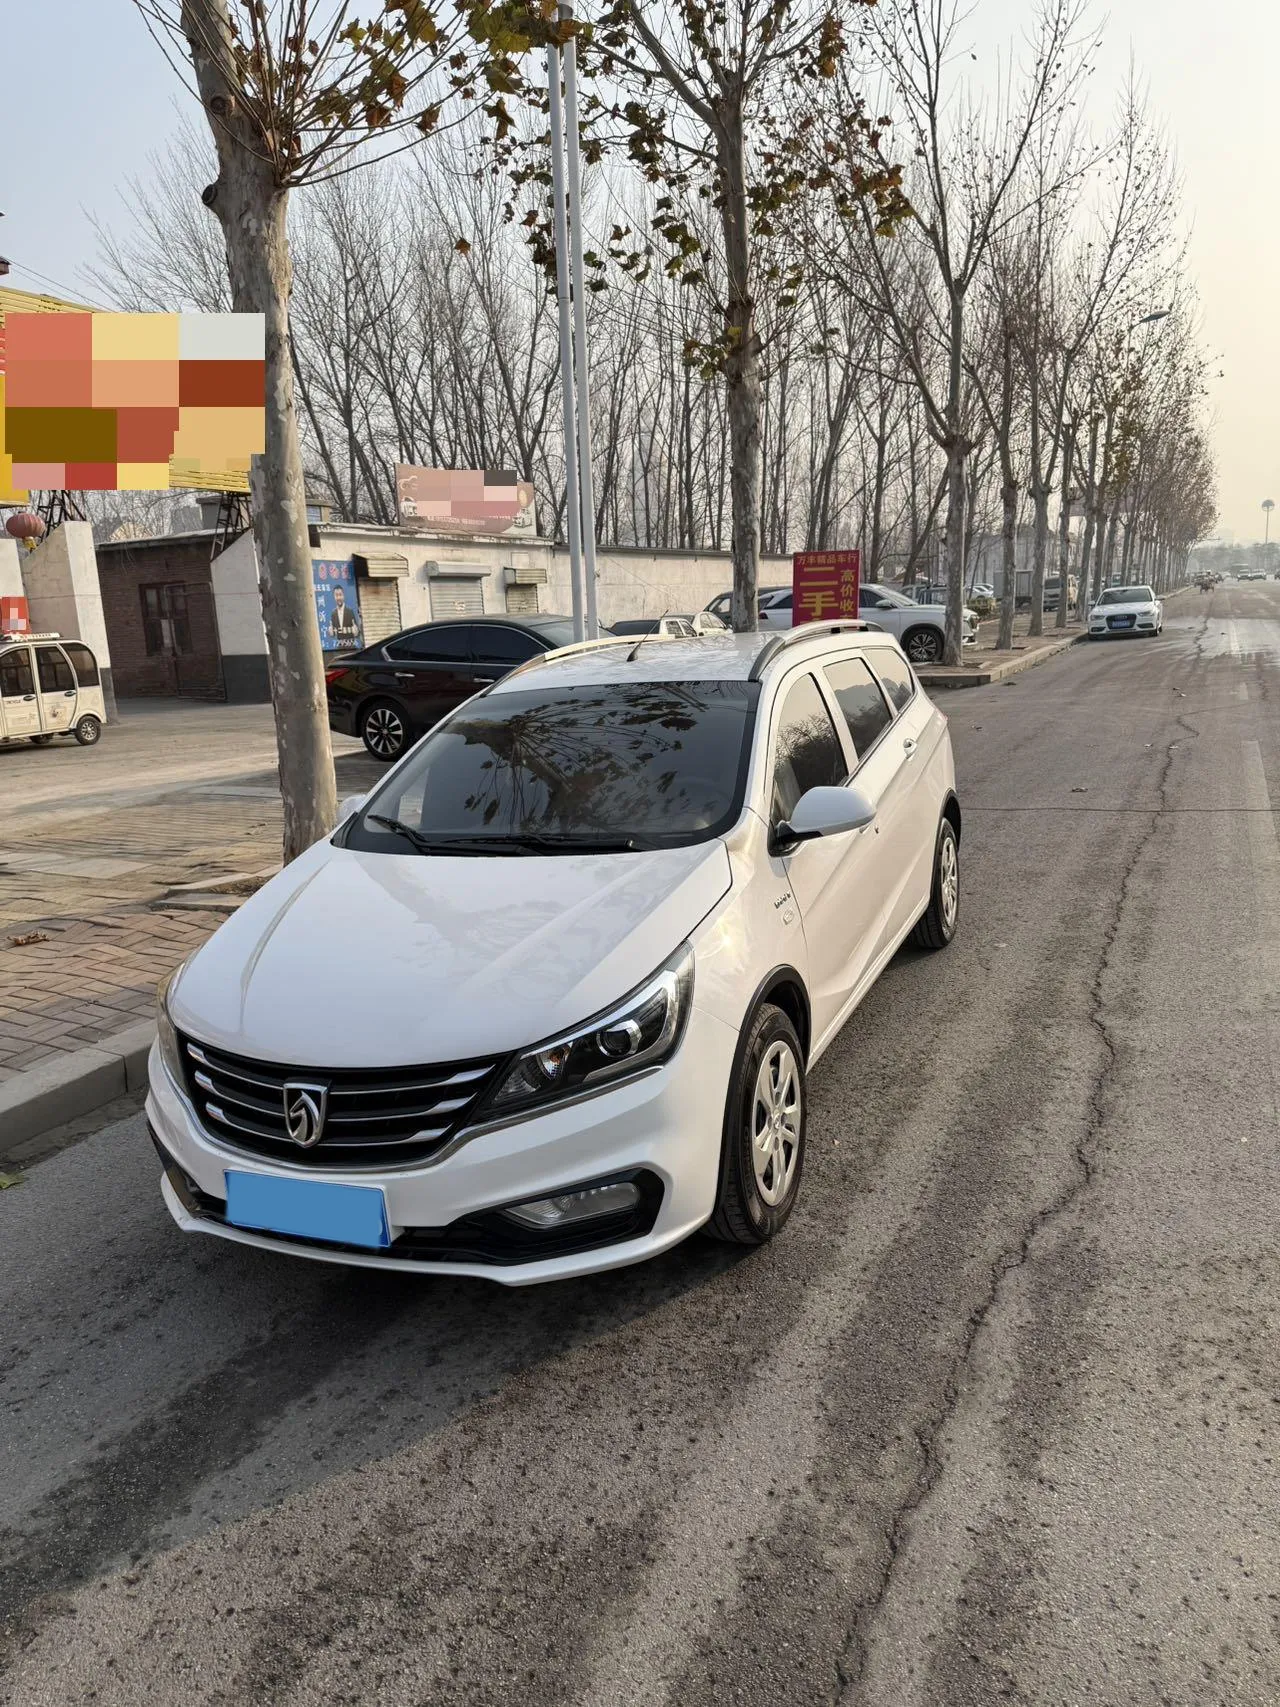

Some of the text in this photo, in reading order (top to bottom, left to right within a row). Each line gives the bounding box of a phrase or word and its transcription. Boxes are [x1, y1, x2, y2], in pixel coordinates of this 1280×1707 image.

[798, 567, 838, 623] 二手
[840, 569, 854, 618] 高价收
